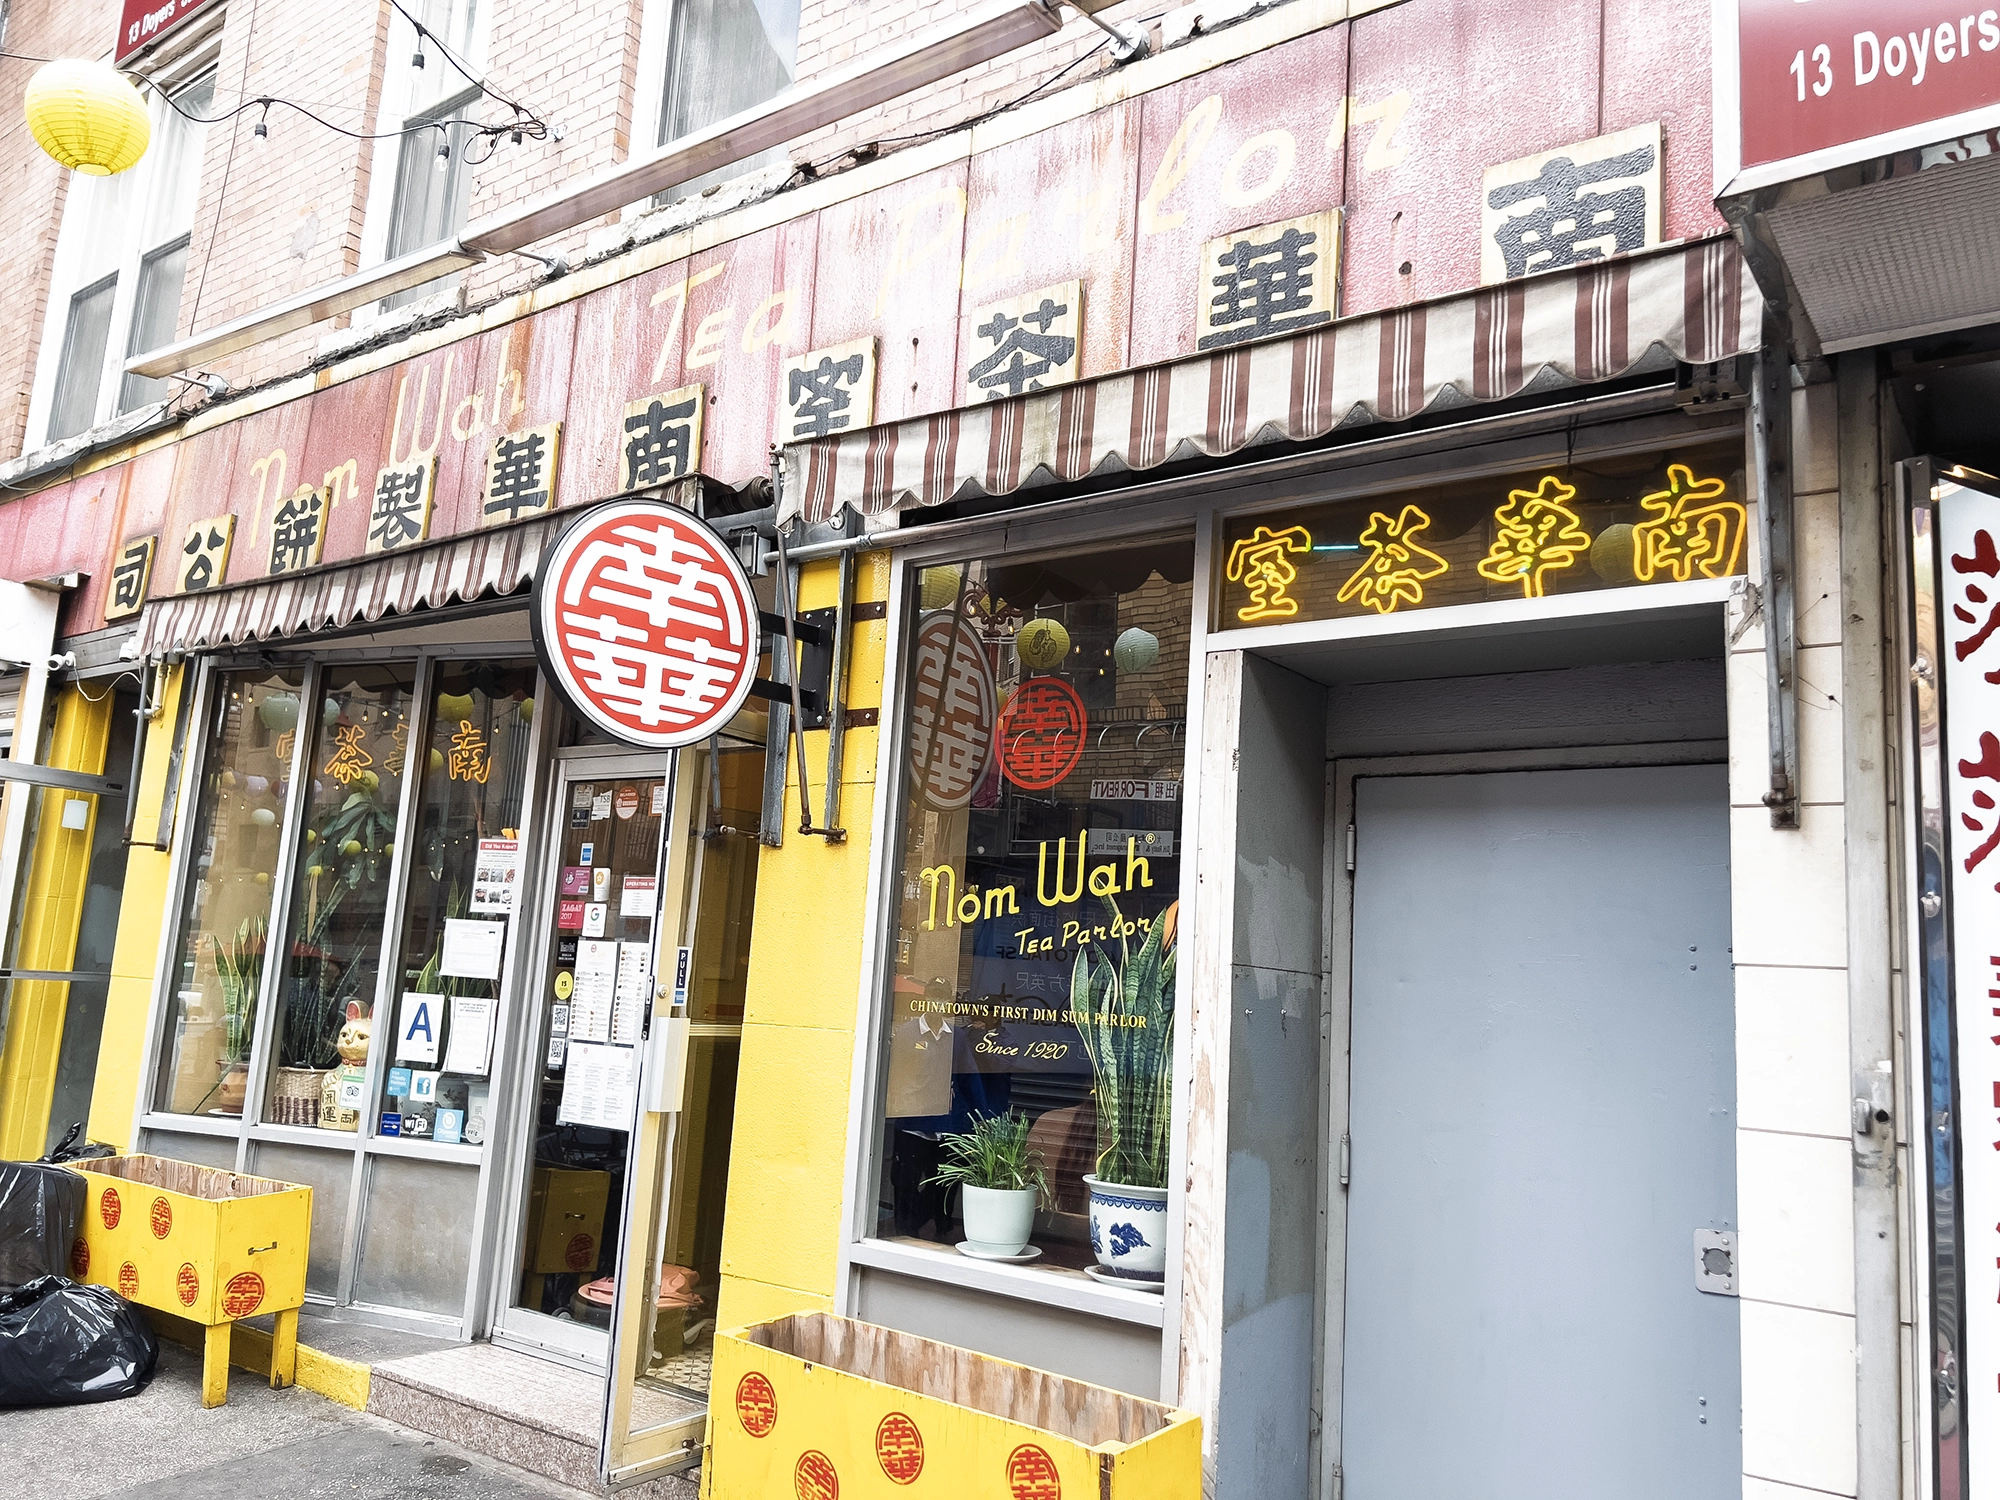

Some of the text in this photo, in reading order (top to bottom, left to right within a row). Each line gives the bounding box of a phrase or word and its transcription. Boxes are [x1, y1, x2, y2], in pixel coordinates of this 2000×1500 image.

[127, 1, 176, 45] 13 Doyers
[1790, 9, 2000, 102] 13 Doyers
[389, 337, 525, 464] Wah
[920, 828, 1153, 931] Nom Wah
[561, 904, 582, 912] ZAGAT
[1014, 914, 1152, 955] Tea Parlor
[678, 952, 686, 986] PULL
[406, 1002, 432, 1042] A
[910, 999, 1147, 1029] CHINATOWN'S FIRST DIM SUM PARLOR
[975, 1031, 1019, 1056] Since
[1023, 1041, 1068, 1060] 1920
